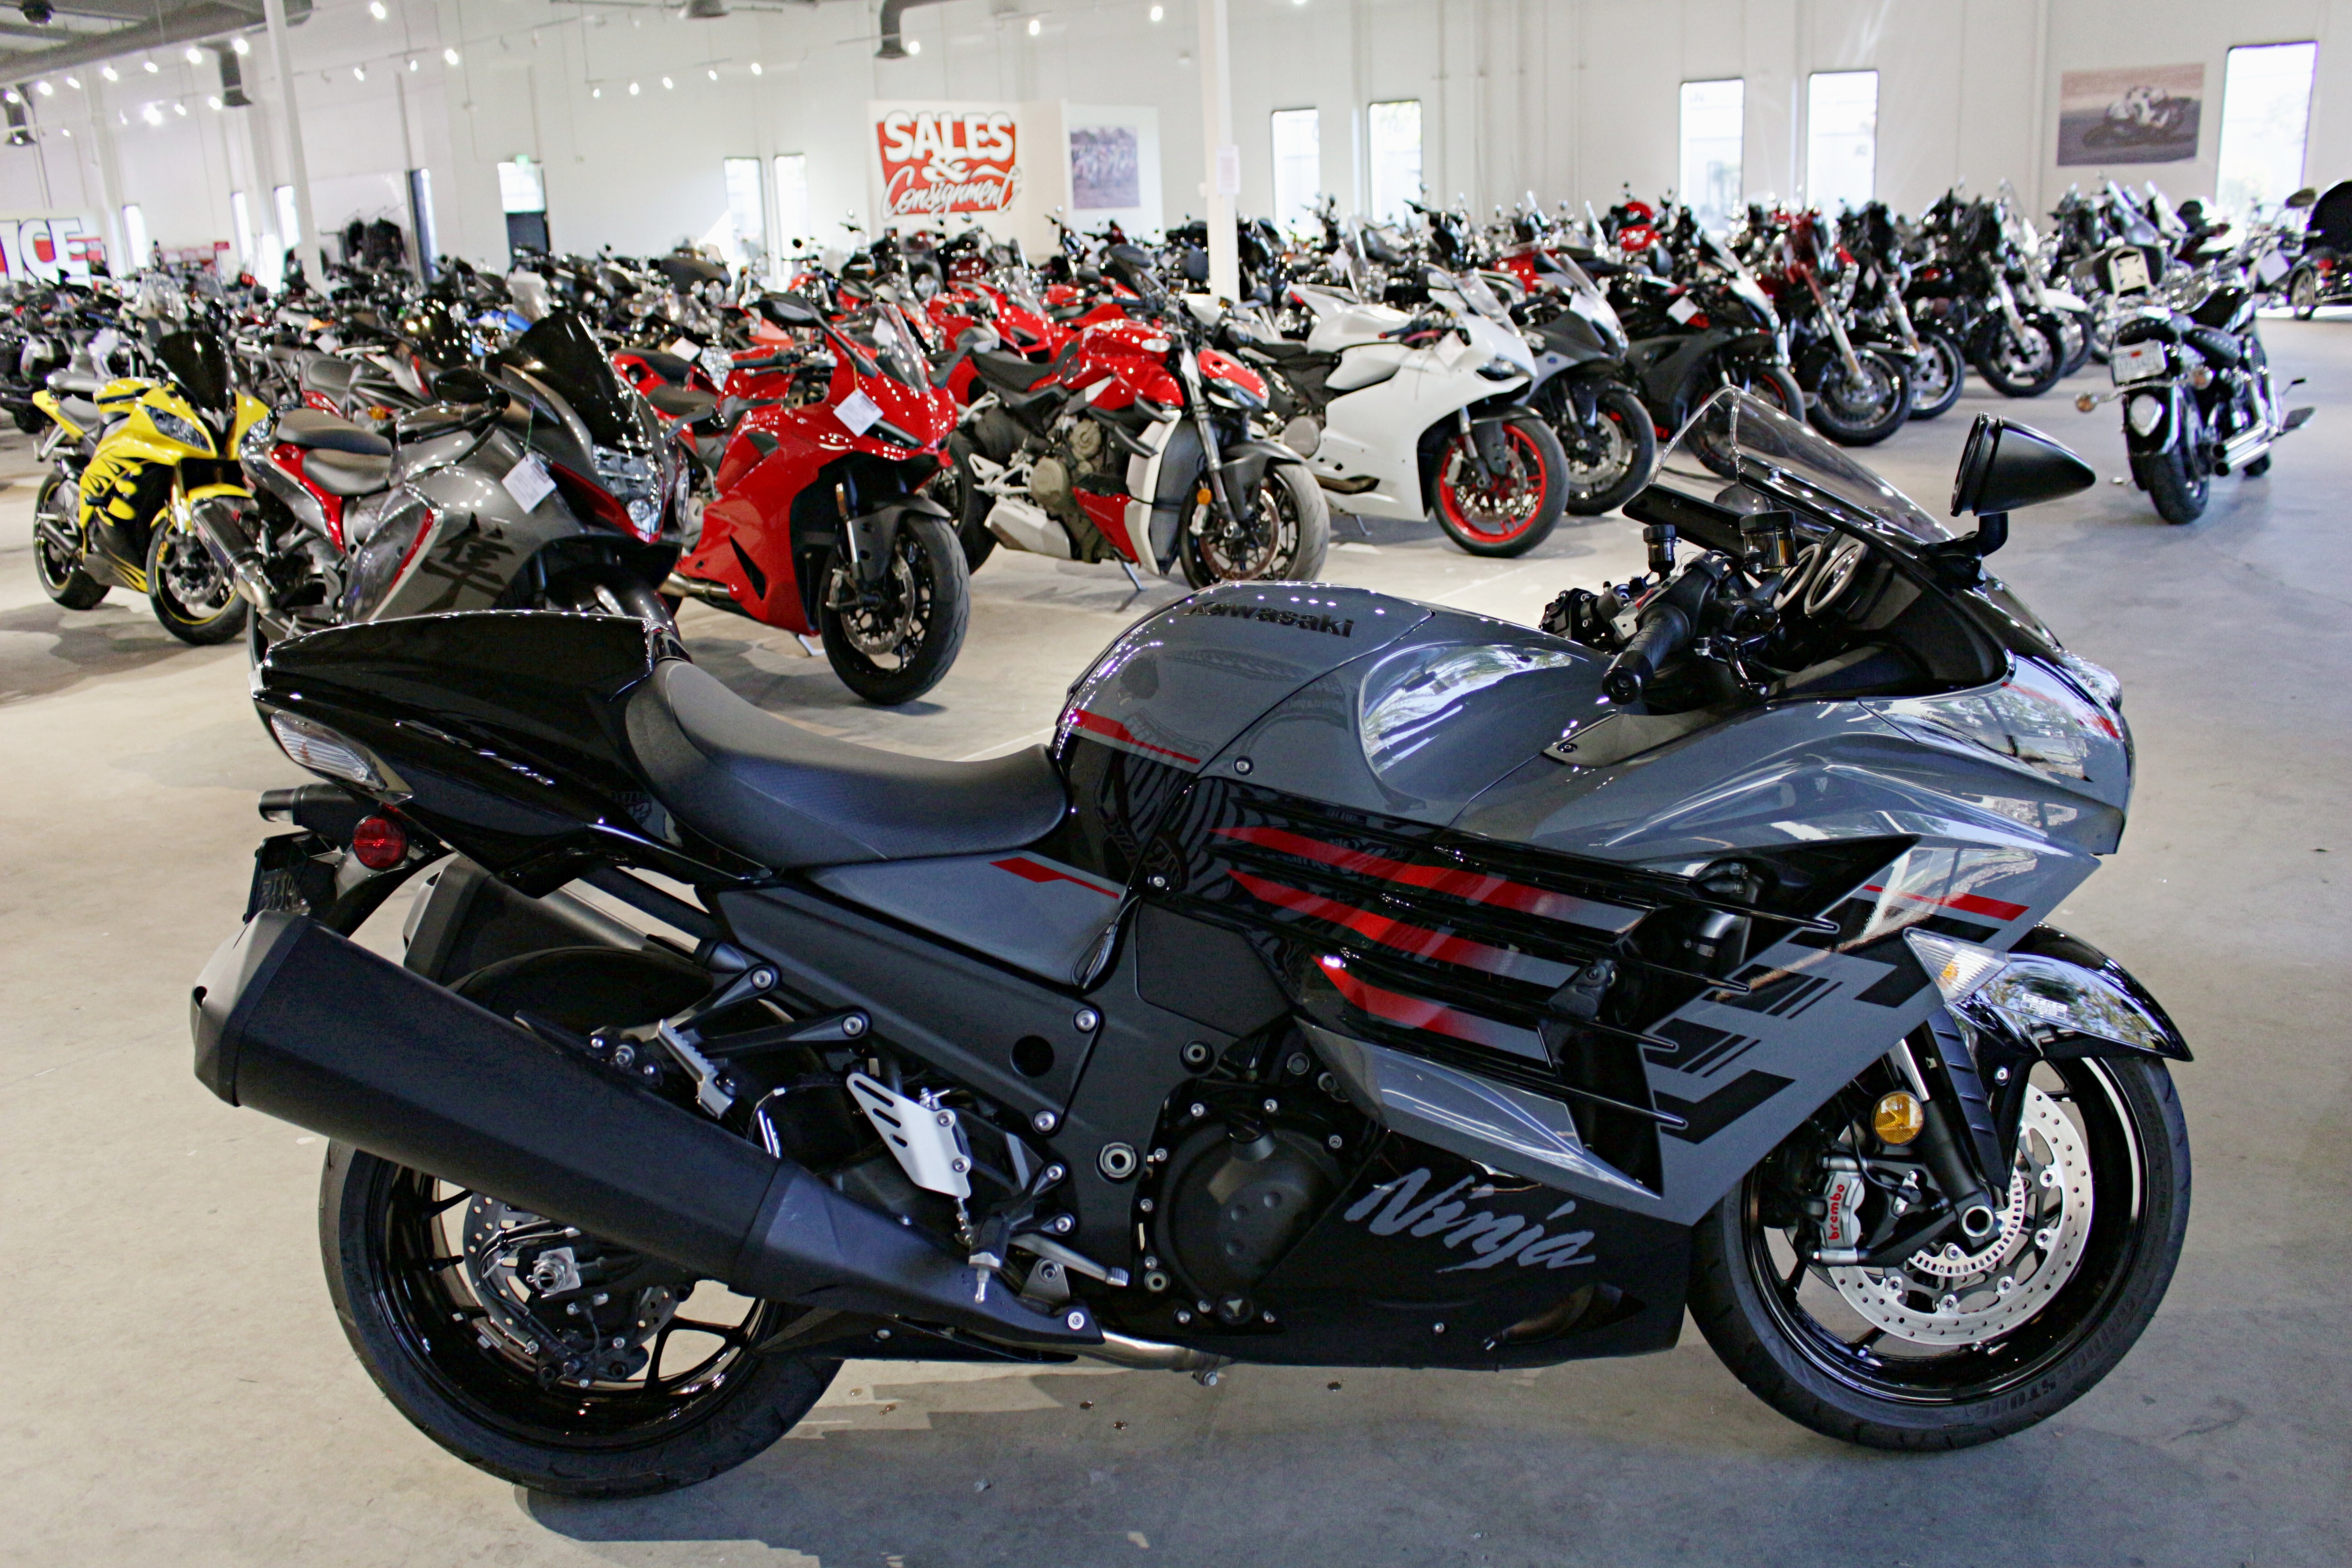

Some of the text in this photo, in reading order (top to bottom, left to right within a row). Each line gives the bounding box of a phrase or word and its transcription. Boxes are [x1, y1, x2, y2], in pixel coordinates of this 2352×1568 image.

[883, 109, 1015, 163] SALES
[880, 165, 1022, 222] Consignment
[921, 154, 974, 183] &
[2024, 994, 2066, 1011] KTRC
[2029, 1003, 2059, 1016] ABS
[1343, 1167, 1596, 1273] Ninja
[1828, 1183, 1845, 1240] brembo
